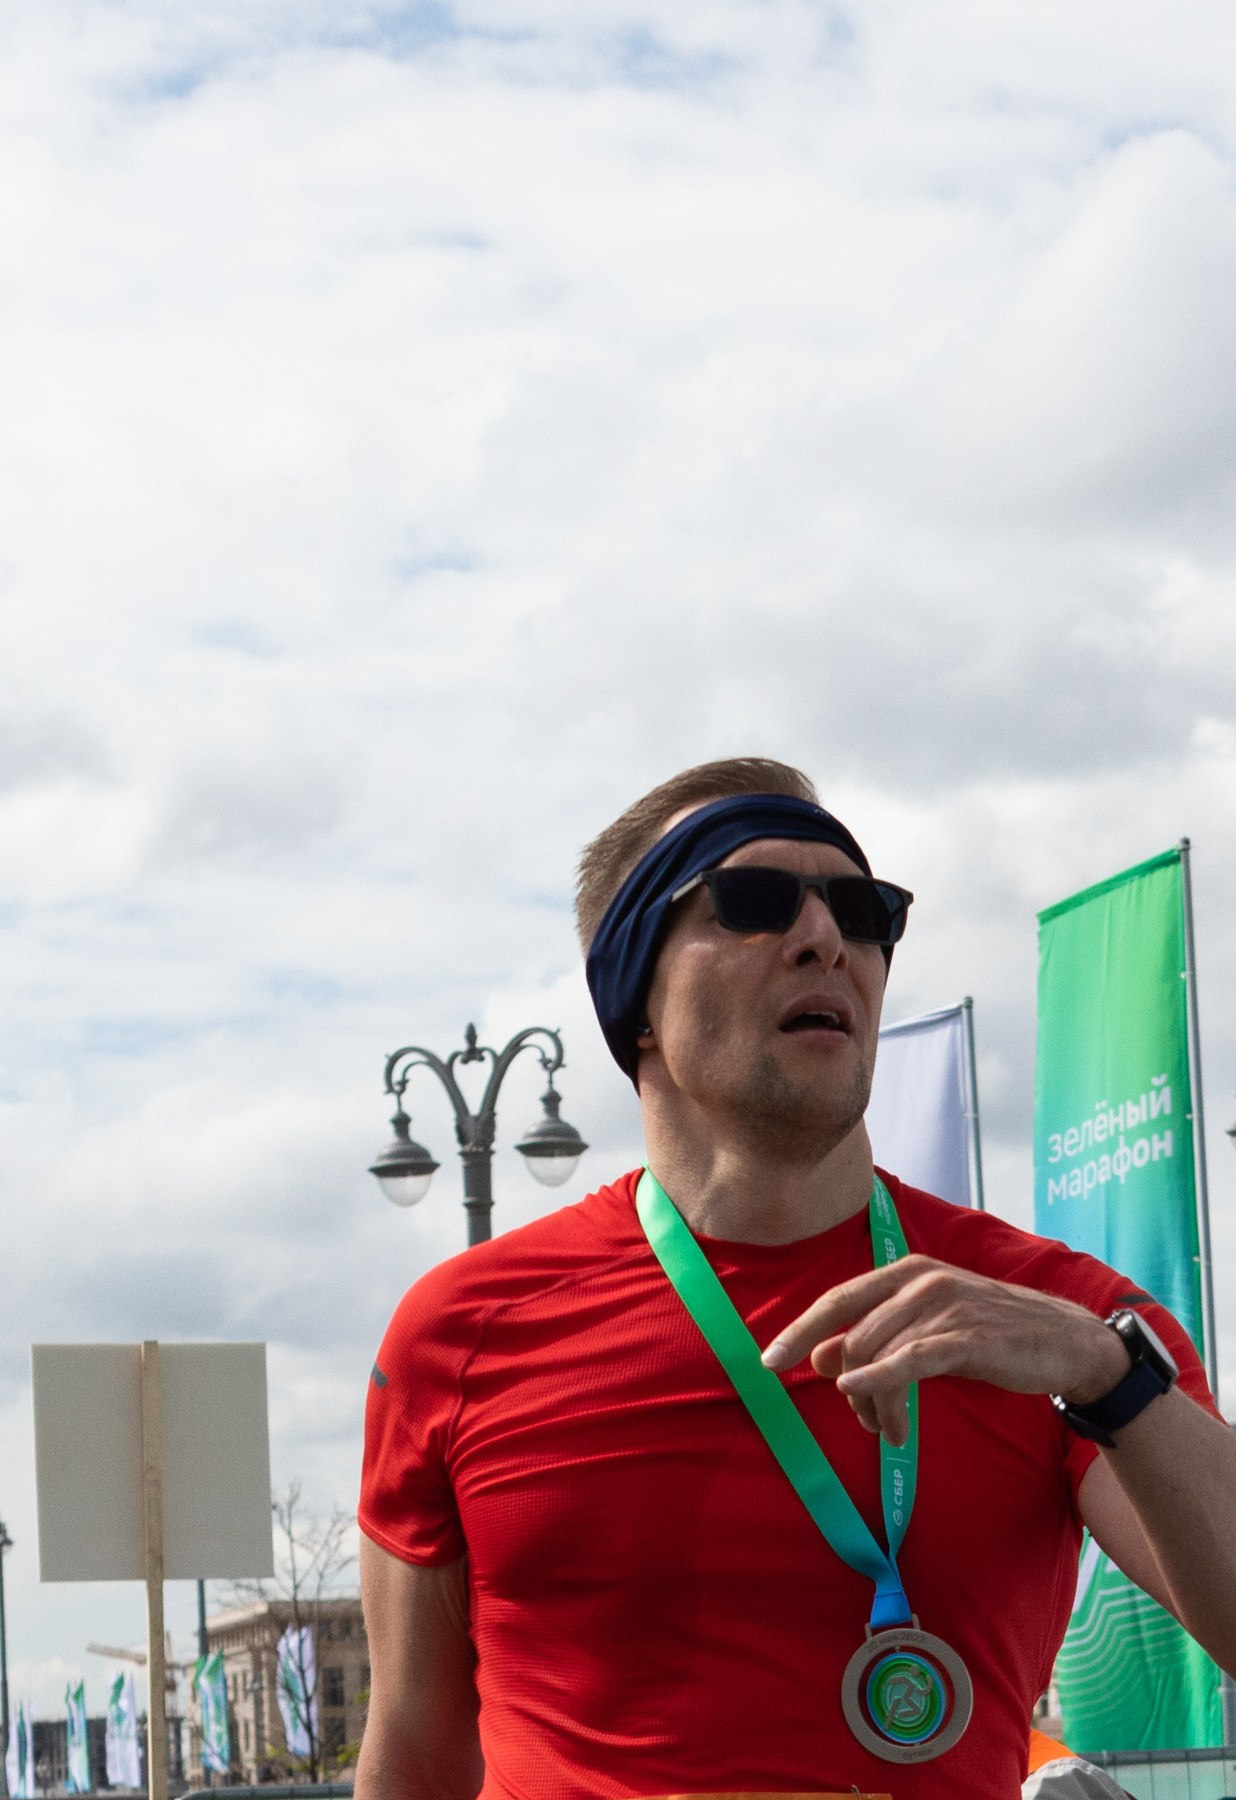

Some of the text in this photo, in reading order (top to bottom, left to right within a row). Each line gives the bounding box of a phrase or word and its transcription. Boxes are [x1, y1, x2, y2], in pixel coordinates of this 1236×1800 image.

[1047, 1073, 1172, 1164] зелёный
[1047, 1130, 1173, 1206] марафон
[893, 1468, 904, 1506] СБЕР
